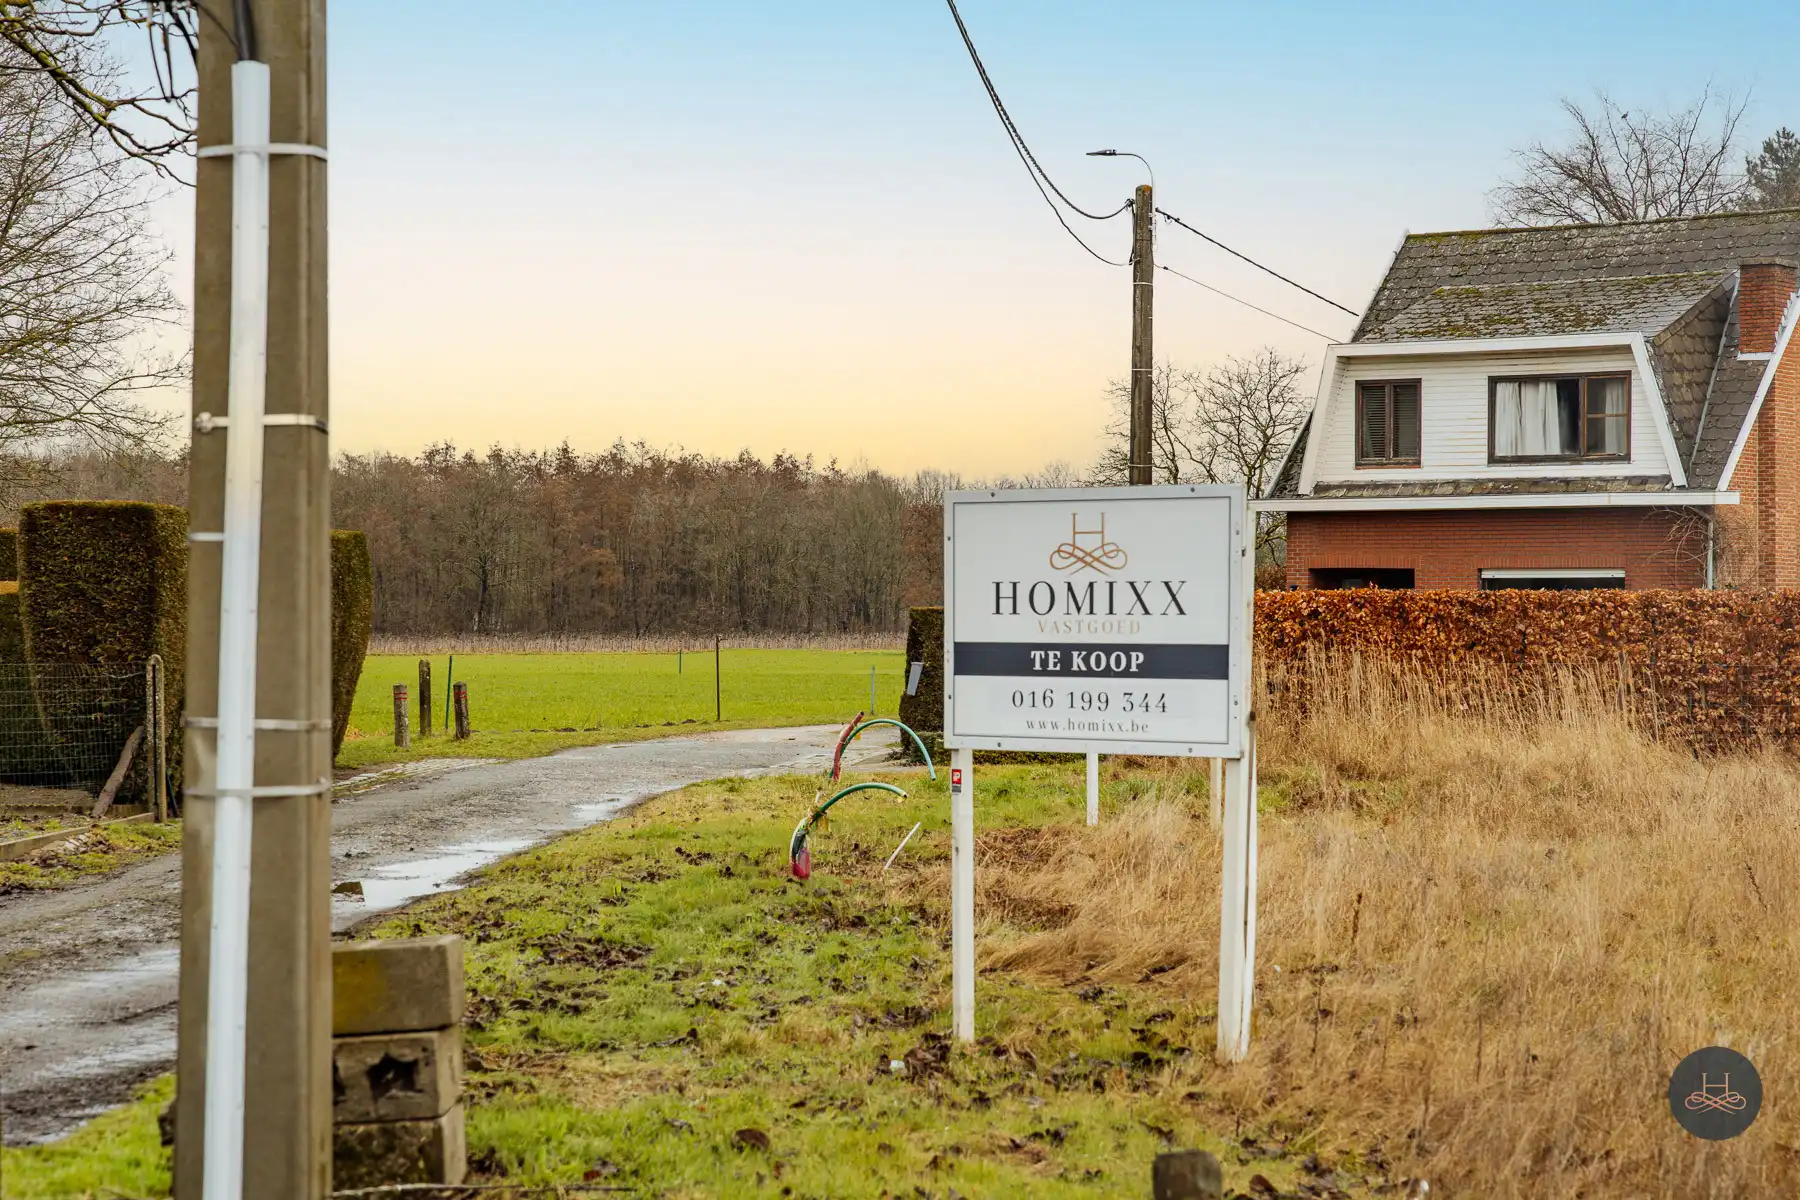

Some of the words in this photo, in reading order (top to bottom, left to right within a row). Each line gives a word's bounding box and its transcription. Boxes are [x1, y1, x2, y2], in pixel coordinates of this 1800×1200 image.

[991, 580, 1188, 616] HOMIXX
[1037, 619, 1141, 635] VASTGOED
[1030, 650, 1061, 671] TE
[1070, 651, 1145, 672] KOOP
[1011, 688, 1054, 709] 016
[1067, 691, 1110, 712] 199
[1122, 692, 1168, 713] 344
[1025, 717, 1149, 733] www.homixx.be
